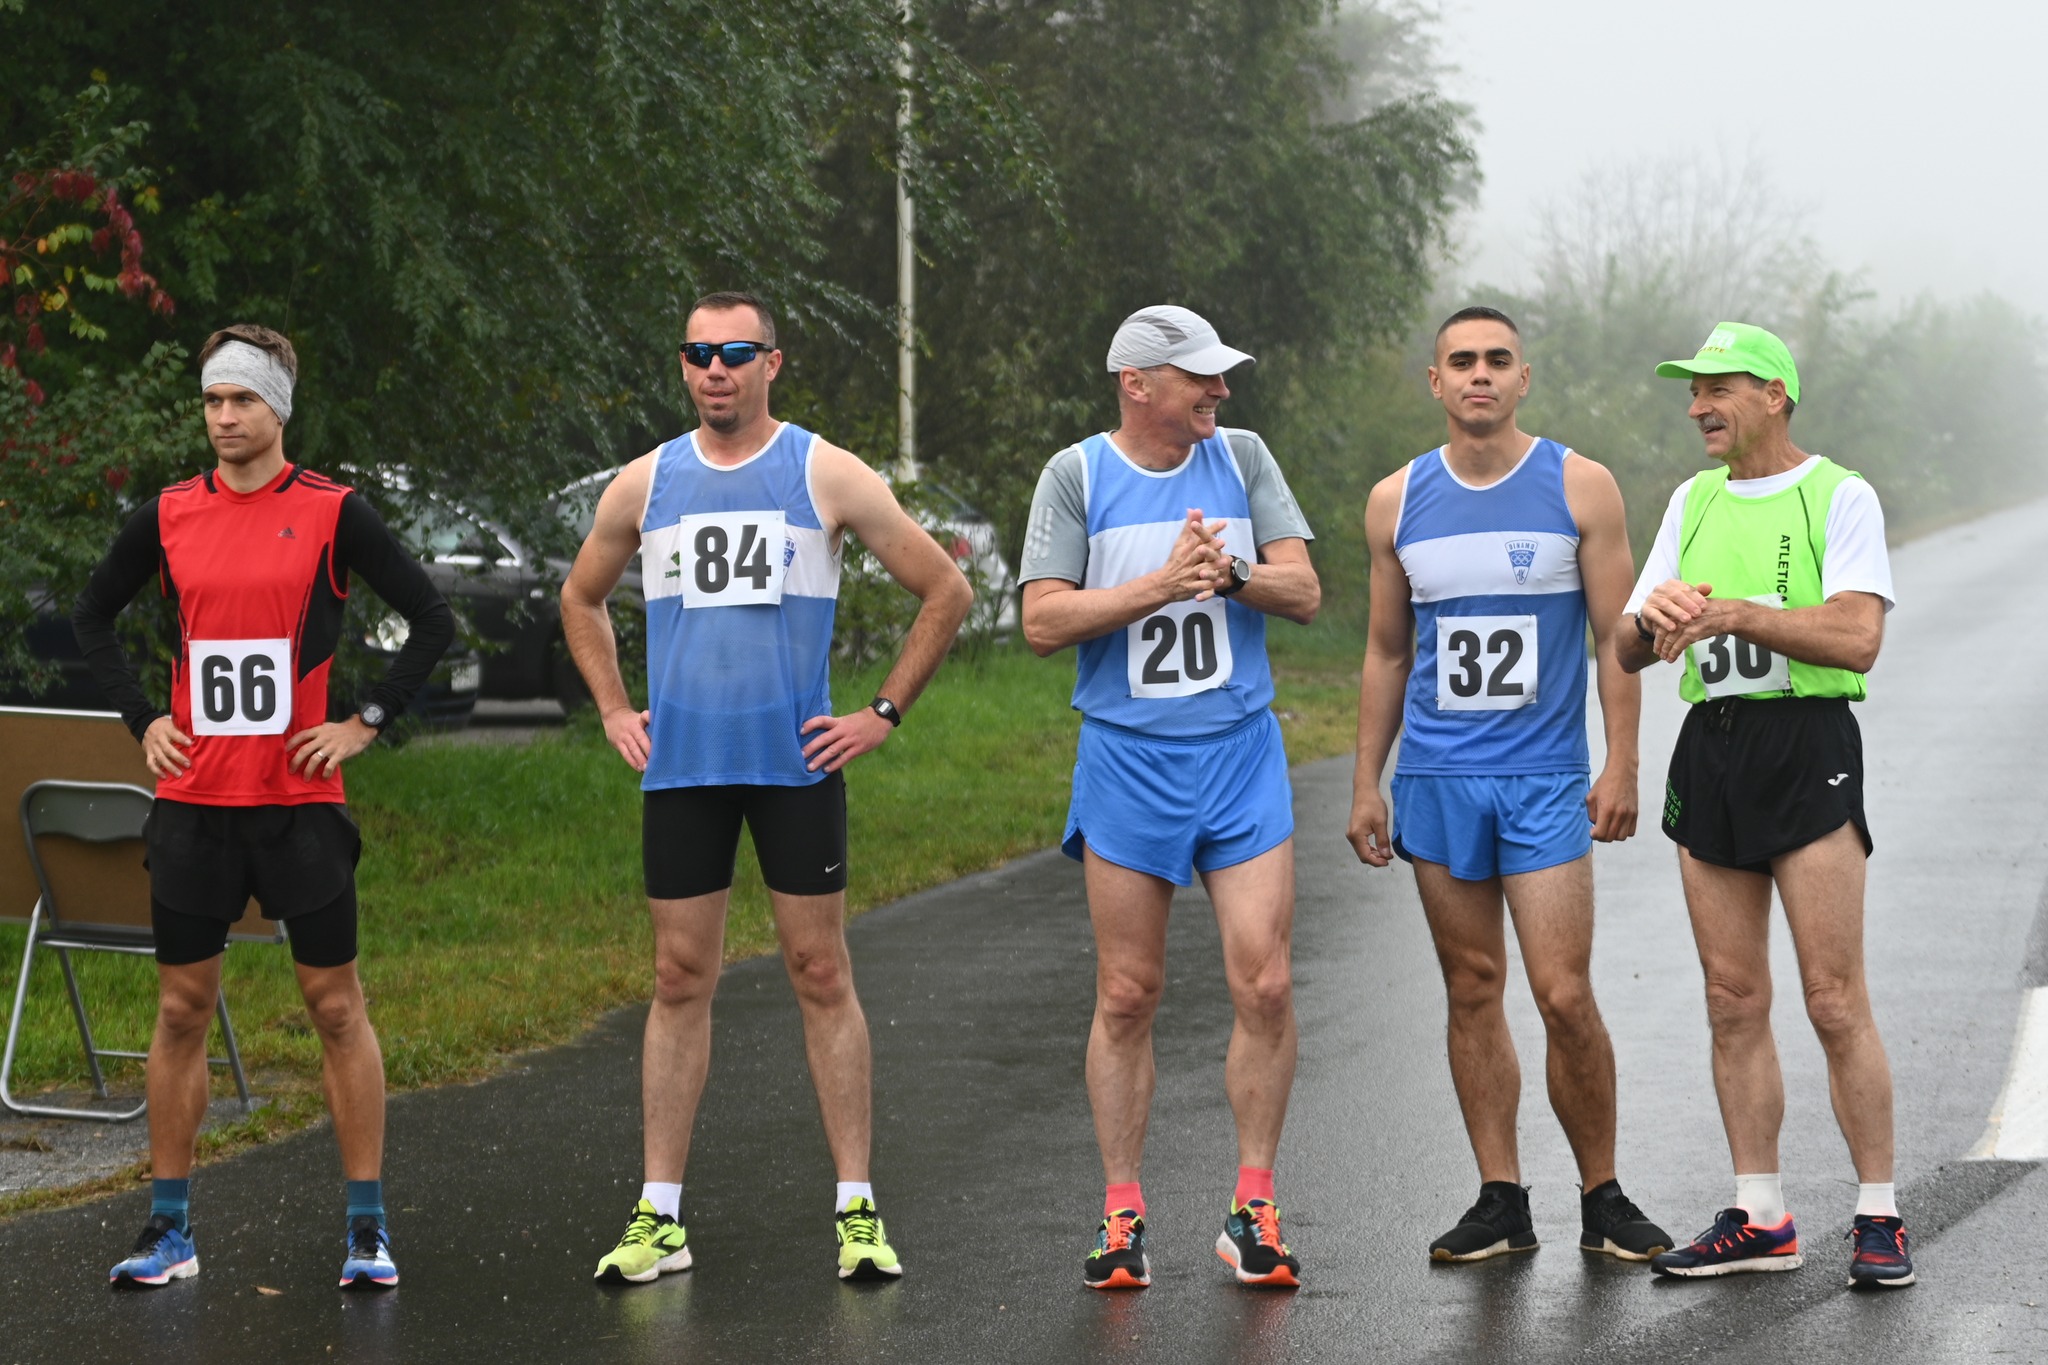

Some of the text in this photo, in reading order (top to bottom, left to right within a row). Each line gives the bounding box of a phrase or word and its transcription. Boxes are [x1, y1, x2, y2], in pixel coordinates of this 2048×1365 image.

[693, 524, 772, 594] 84
[1508, 542, 1535, 550] DINAMO
[1776, 533, 1791, 603] ATLETICA
[1141, 611, 1218, 685] 20
[1447, 629, 1524, 697] 32
[1700, 633, 1772, 685] 30
[201, 653, 276, 723] 66
